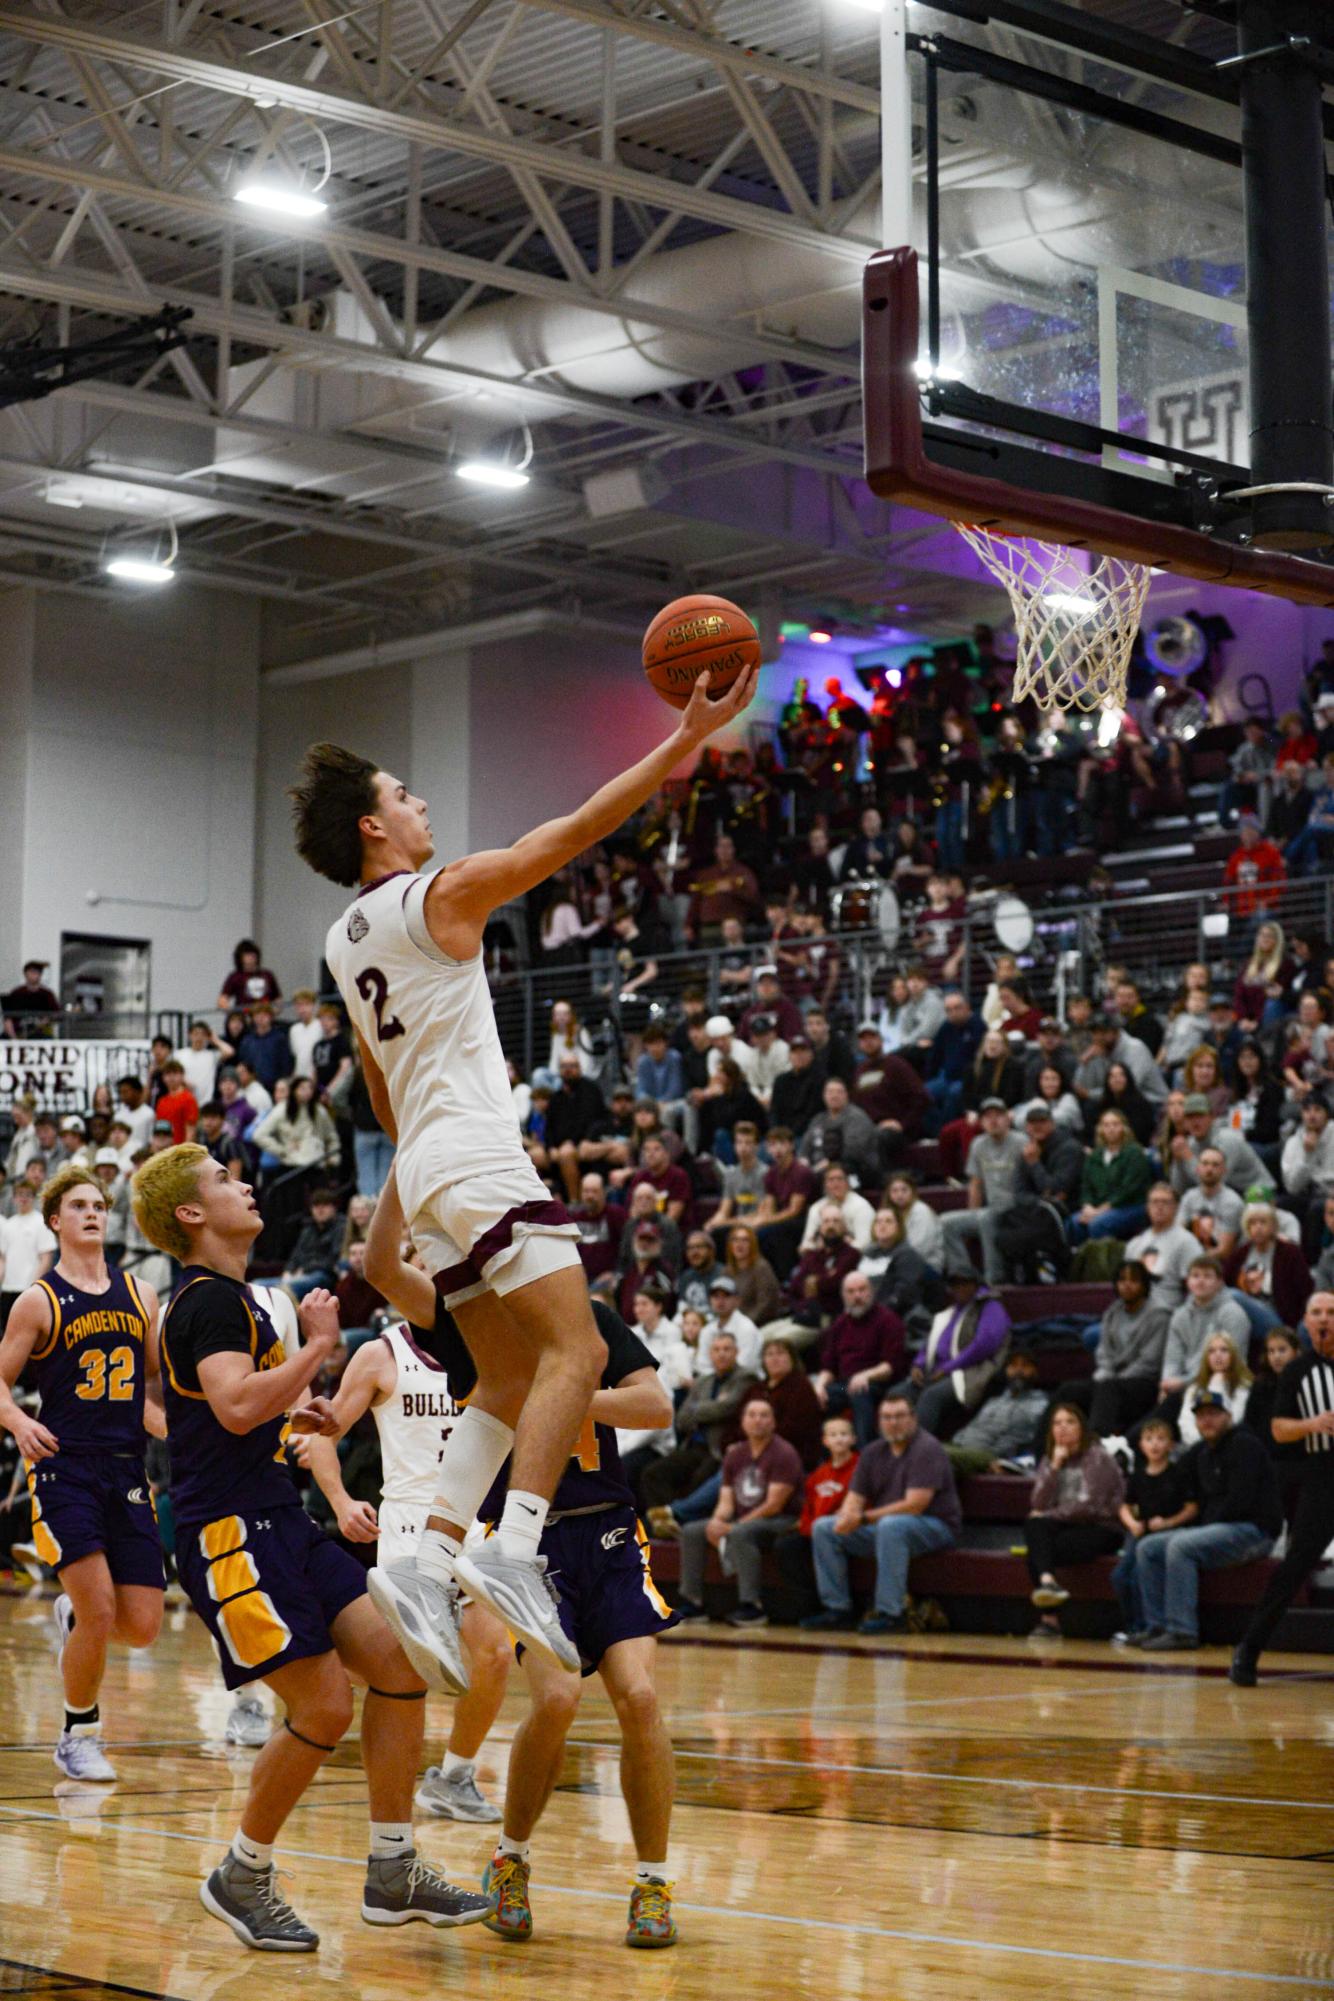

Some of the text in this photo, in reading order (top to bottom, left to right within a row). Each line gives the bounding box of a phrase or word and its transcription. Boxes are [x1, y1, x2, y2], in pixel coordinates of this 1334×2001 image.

[355, 966, 406, 1042] 2
[64, 1309, 143, 1351] CAMDENTON
[75, 1346, 135, 1401] 32
